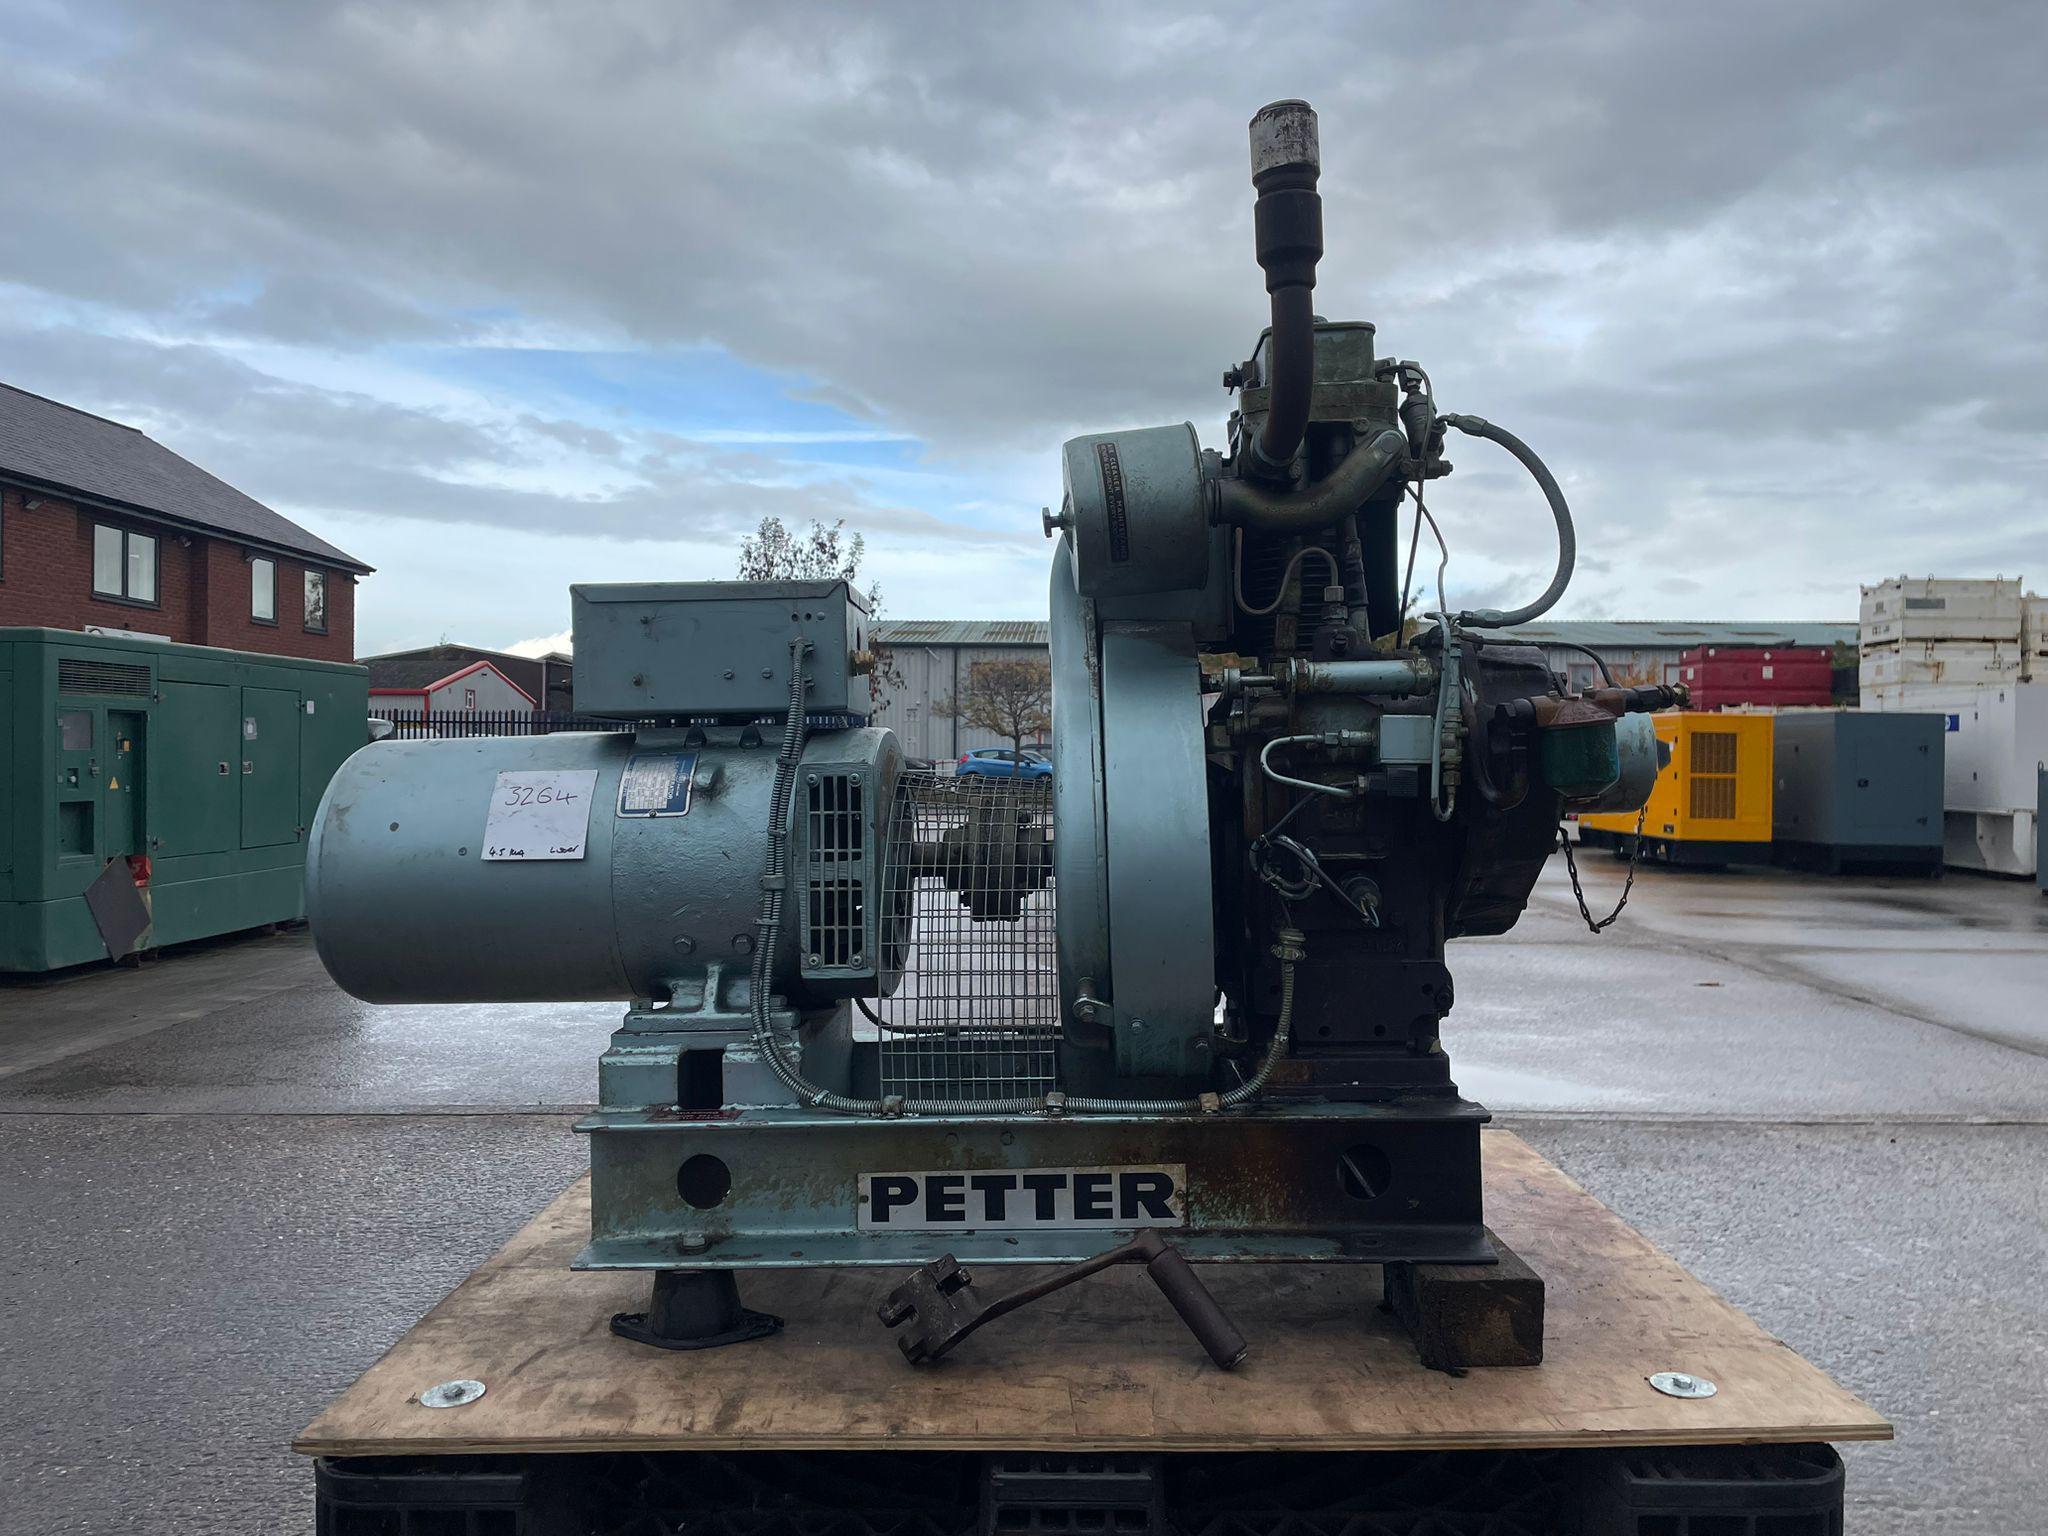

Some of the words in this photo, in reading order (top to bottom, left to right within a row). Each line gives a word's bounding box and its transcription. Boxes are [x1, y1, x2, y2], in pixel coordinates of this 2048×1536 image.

[504, 786, 578, 806] 3264
[489, 846, 506, 857] 4.5
[870, 1172, 1177, 1223] PETTER
